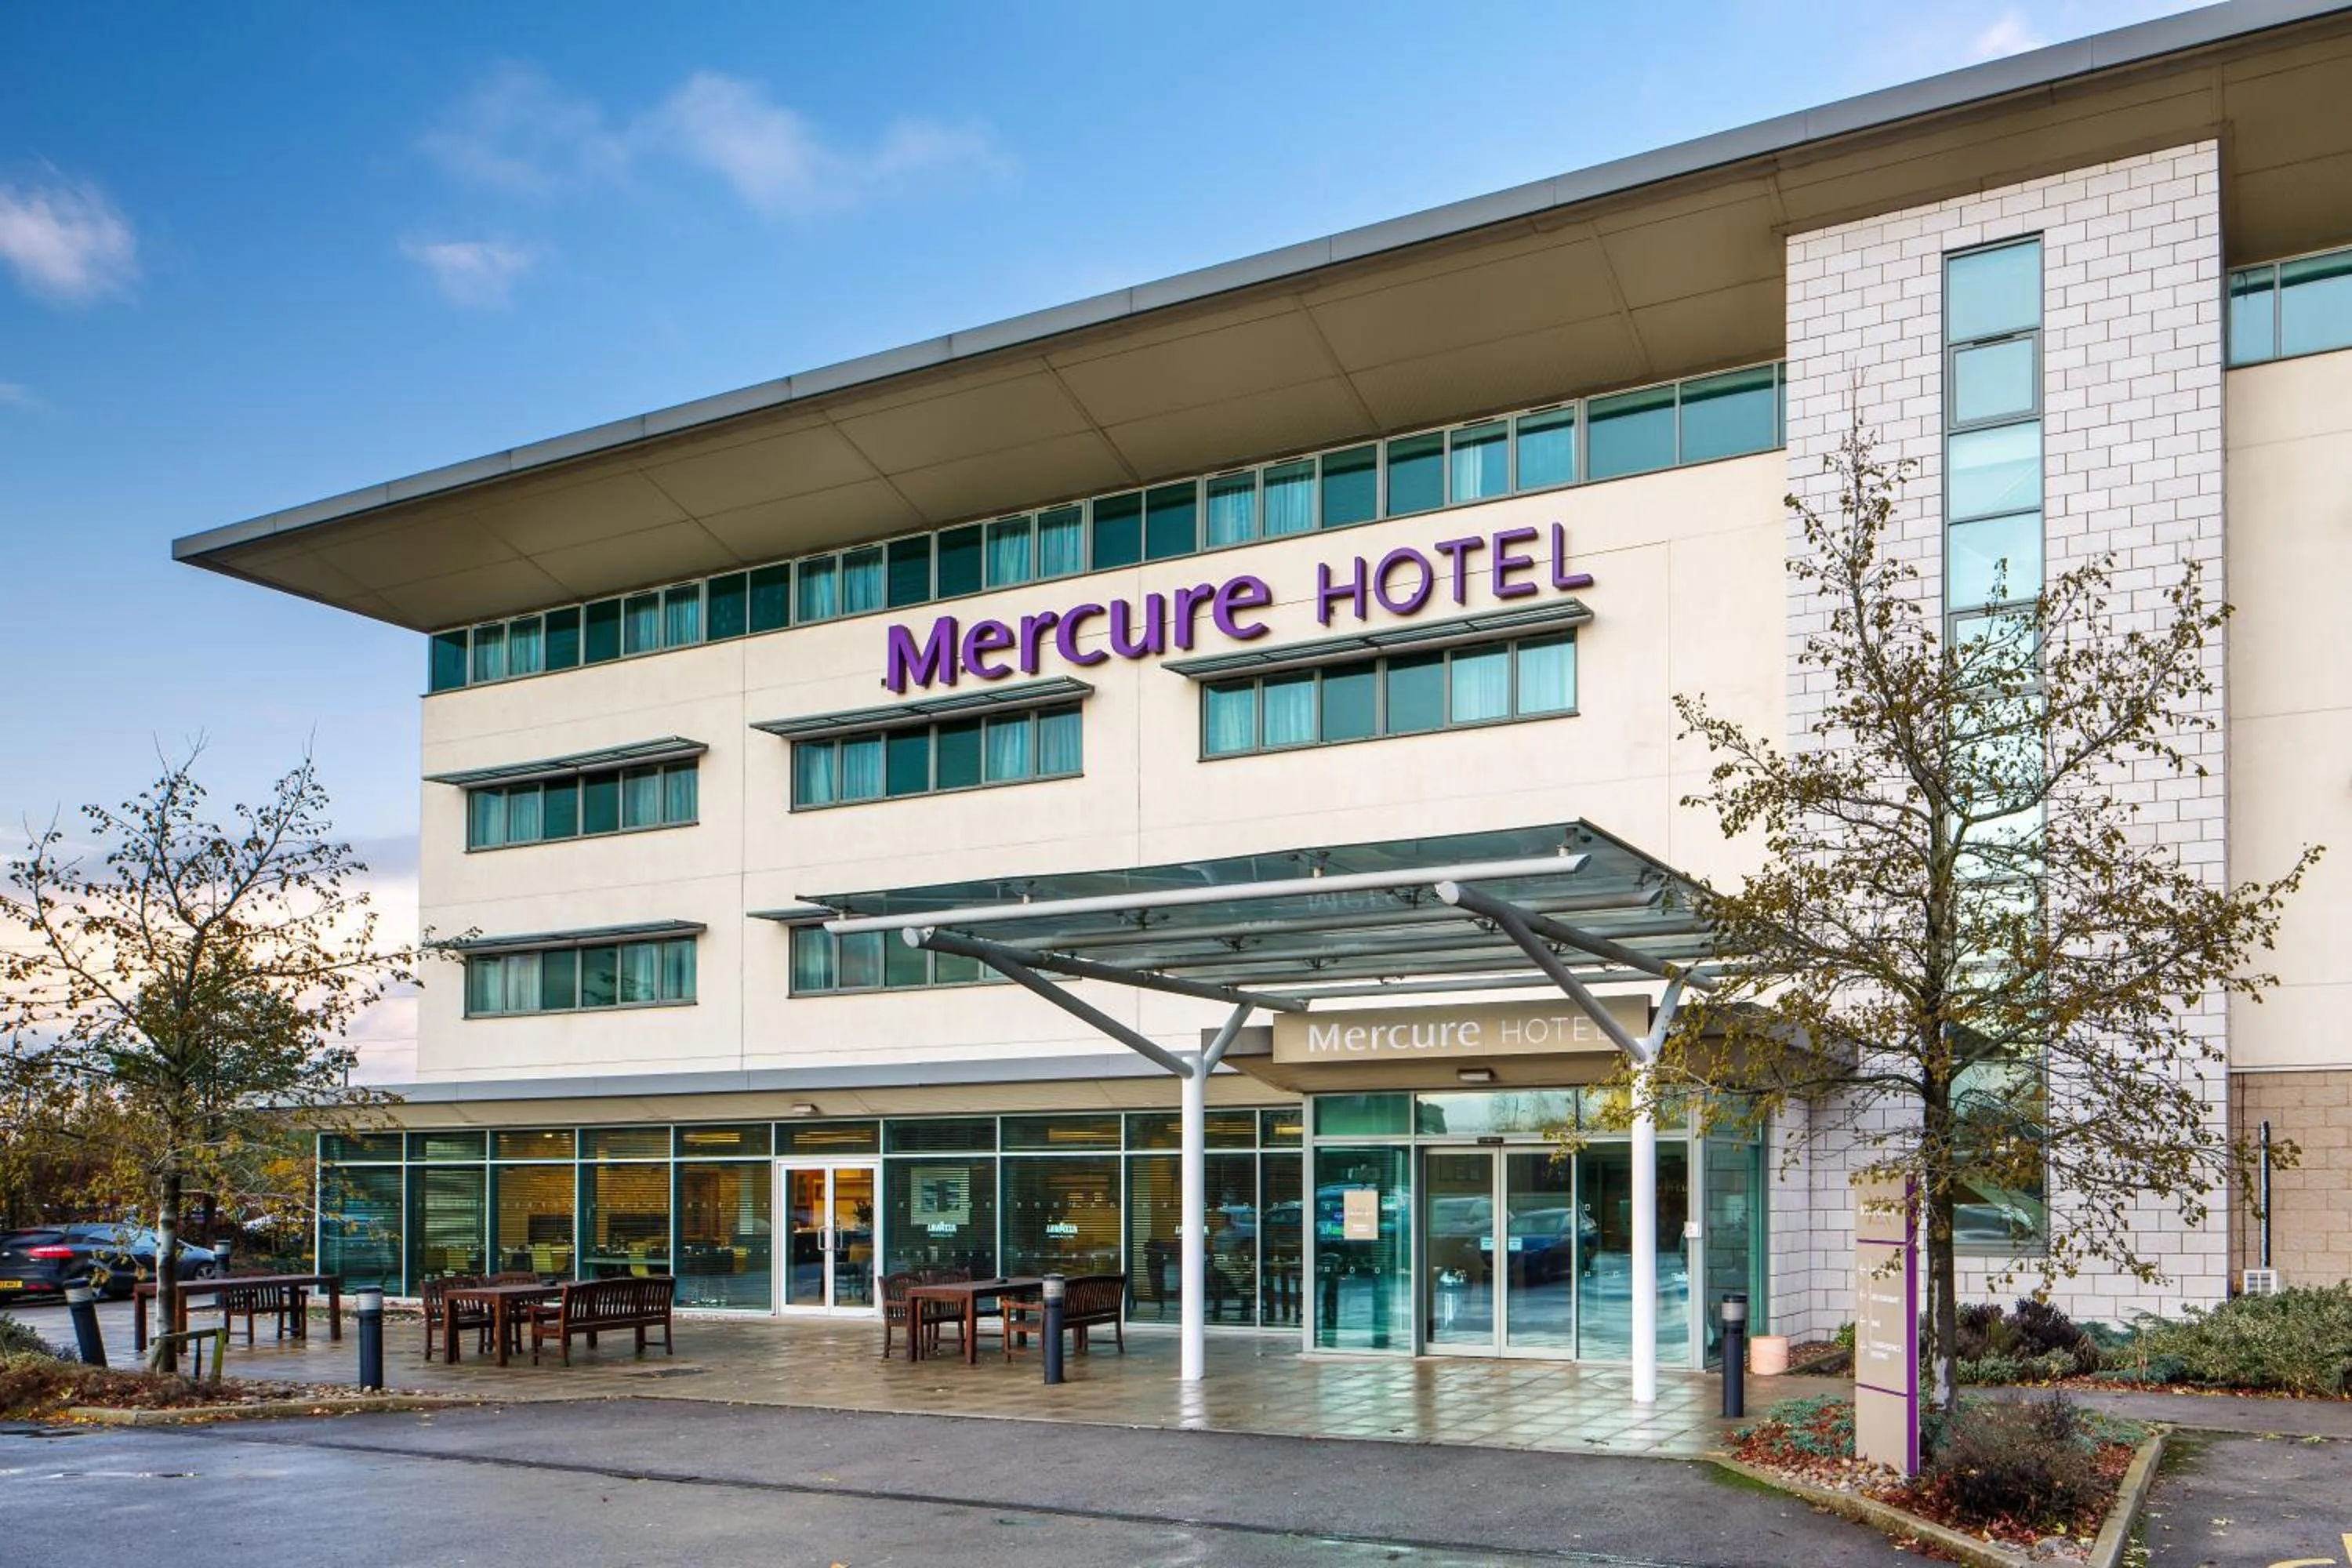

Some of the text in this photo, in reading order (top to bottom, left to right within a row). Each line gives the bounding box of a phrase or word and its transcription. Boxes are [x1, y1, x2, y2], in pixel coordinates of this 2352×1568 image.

[887, 522, 1592, 692] Mercure HOTEL
[1307, 1019, 1481, 1053] Mercure
